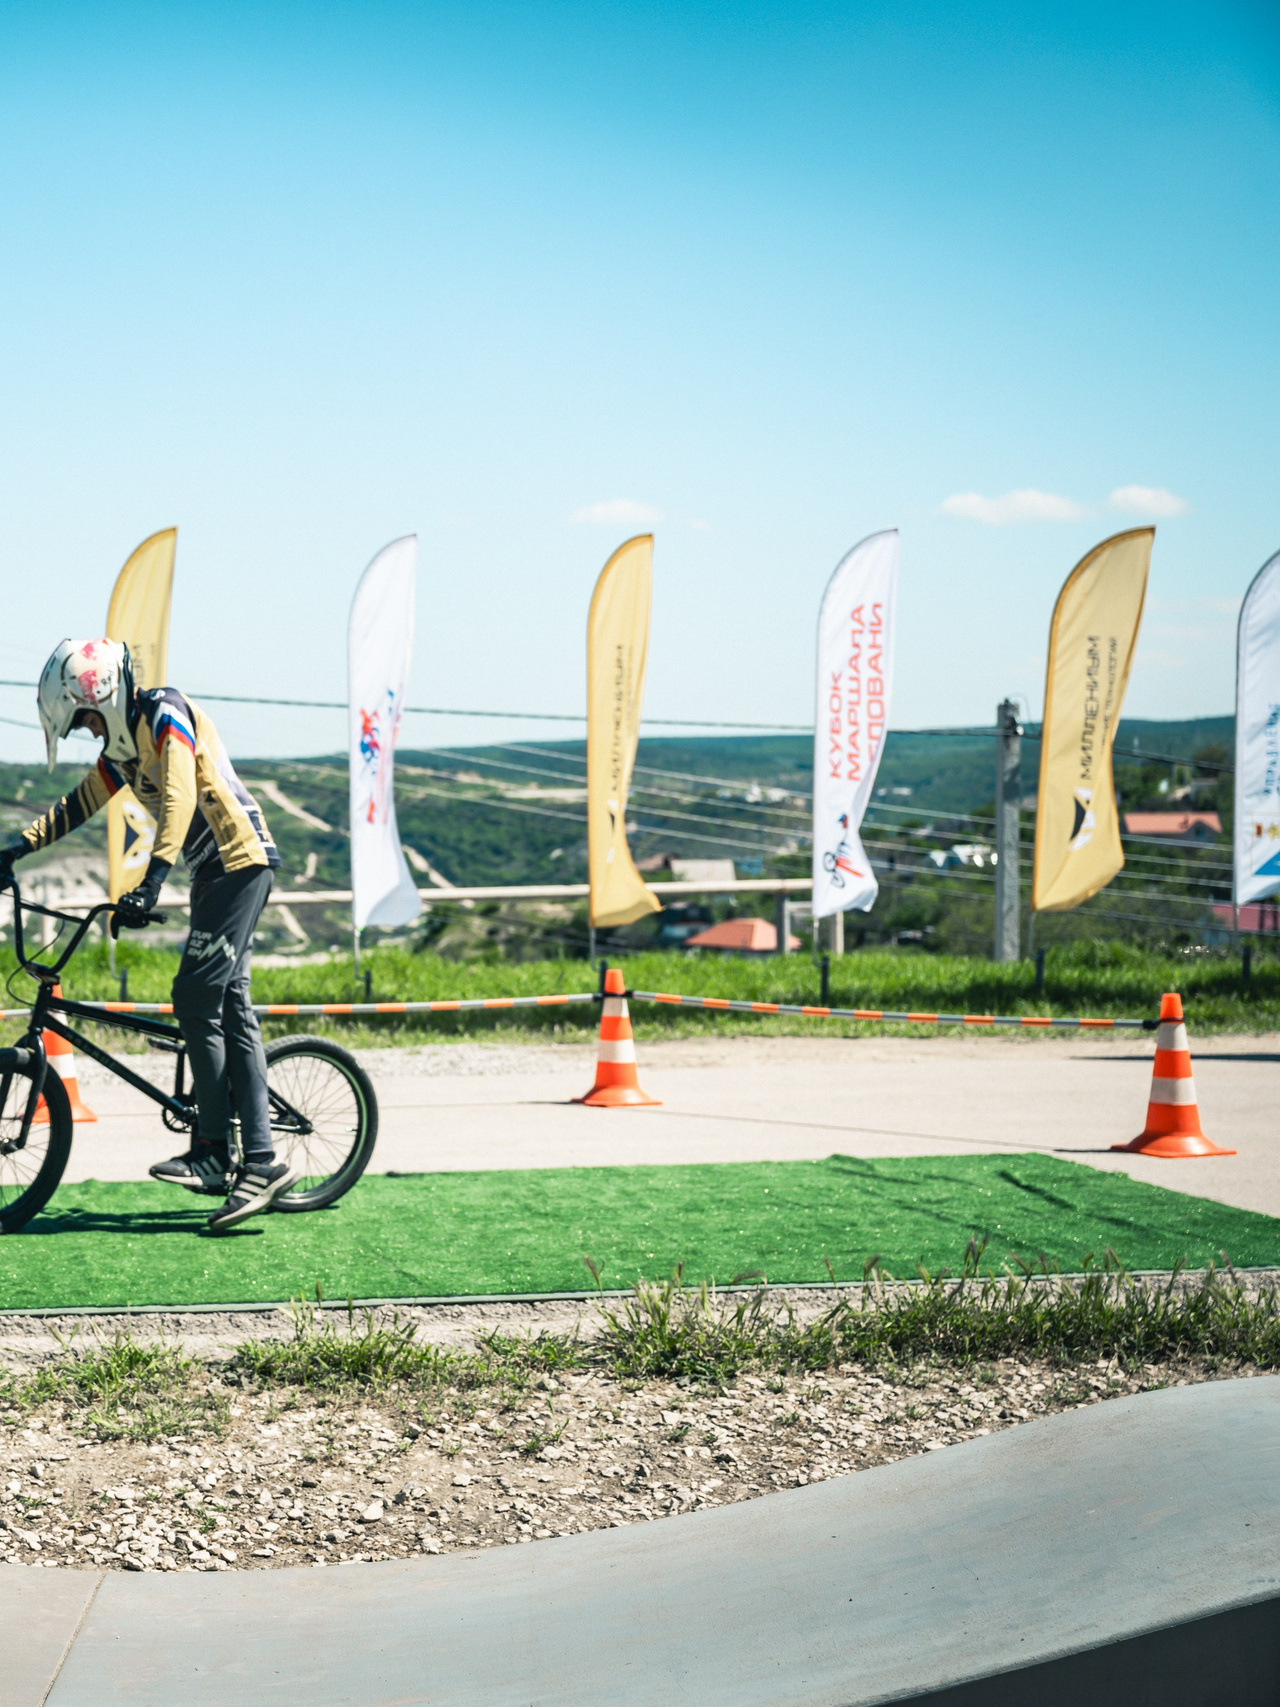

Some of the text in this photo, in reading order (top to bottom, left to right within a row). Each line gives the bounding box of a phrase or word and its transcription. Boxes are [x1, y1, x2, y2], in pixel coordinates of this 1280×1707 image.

[829, 671, 843, 779] КУБОК
[847, 604, 866, 782] МАРШАЛА
[1080, 635, 1100, 780] МИЛЛЕНИУМ
